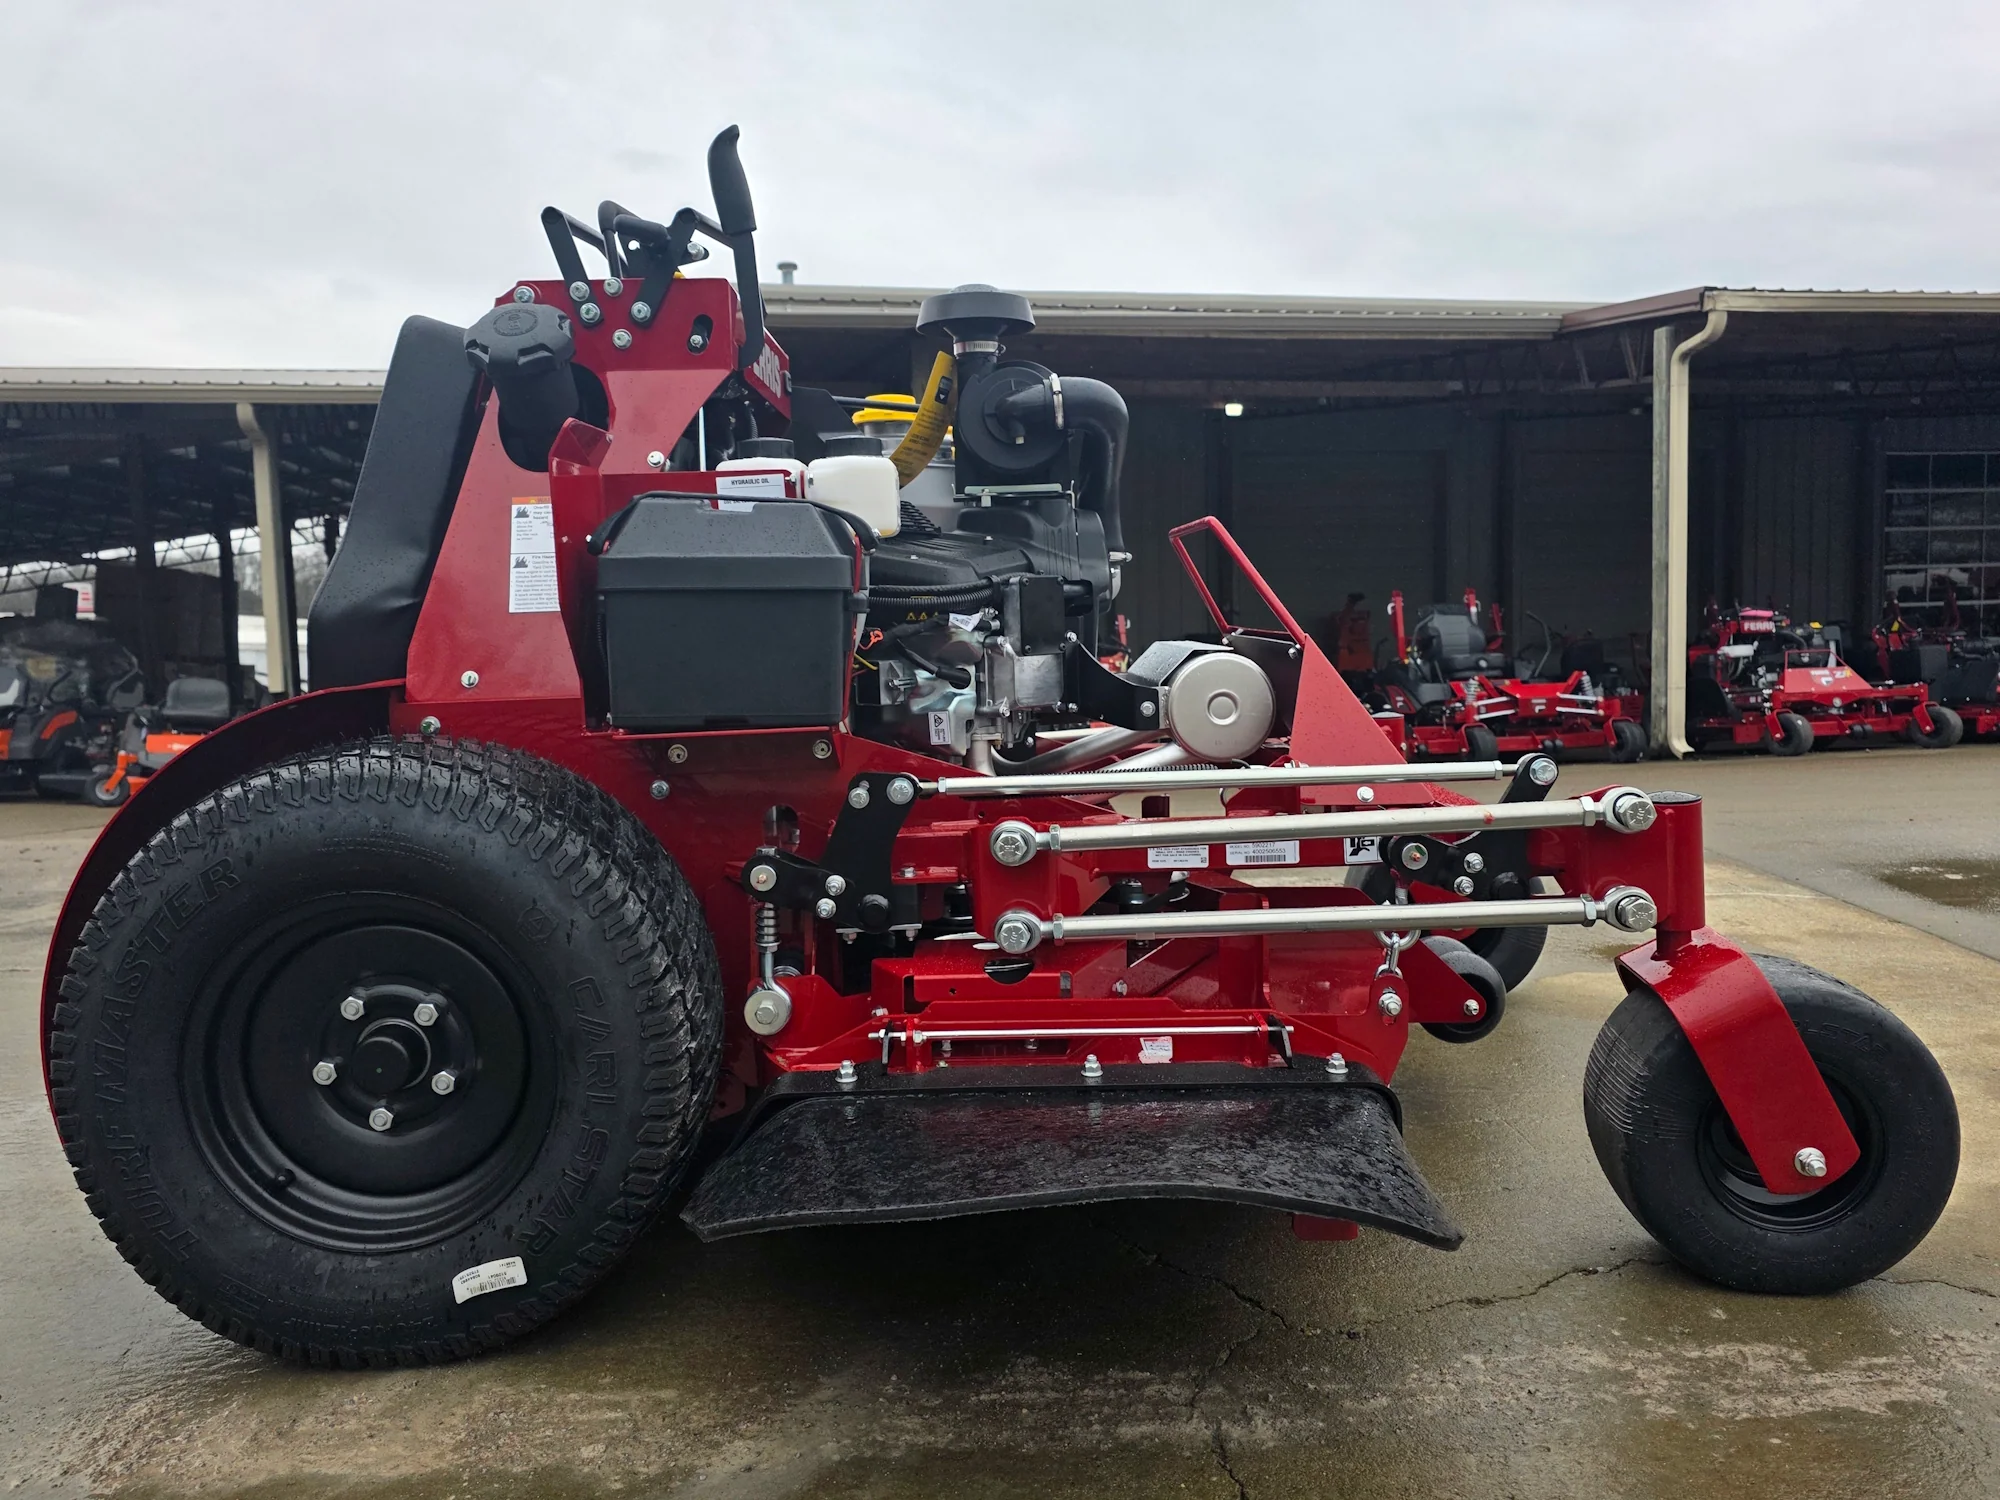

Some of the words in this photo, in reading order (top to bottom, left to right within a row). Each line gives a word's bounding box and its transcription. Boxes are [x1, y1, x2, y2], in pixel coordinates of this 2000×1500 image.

[731, 478, 760, 486] HYDRAULIC
[1743, 621, 1776, 632] FERRI
[93, 855, 241, 1103] MASTER
[96, 1112, 200, 1262] TURF
[522, 975, 618, 1258] CARLSTAR
